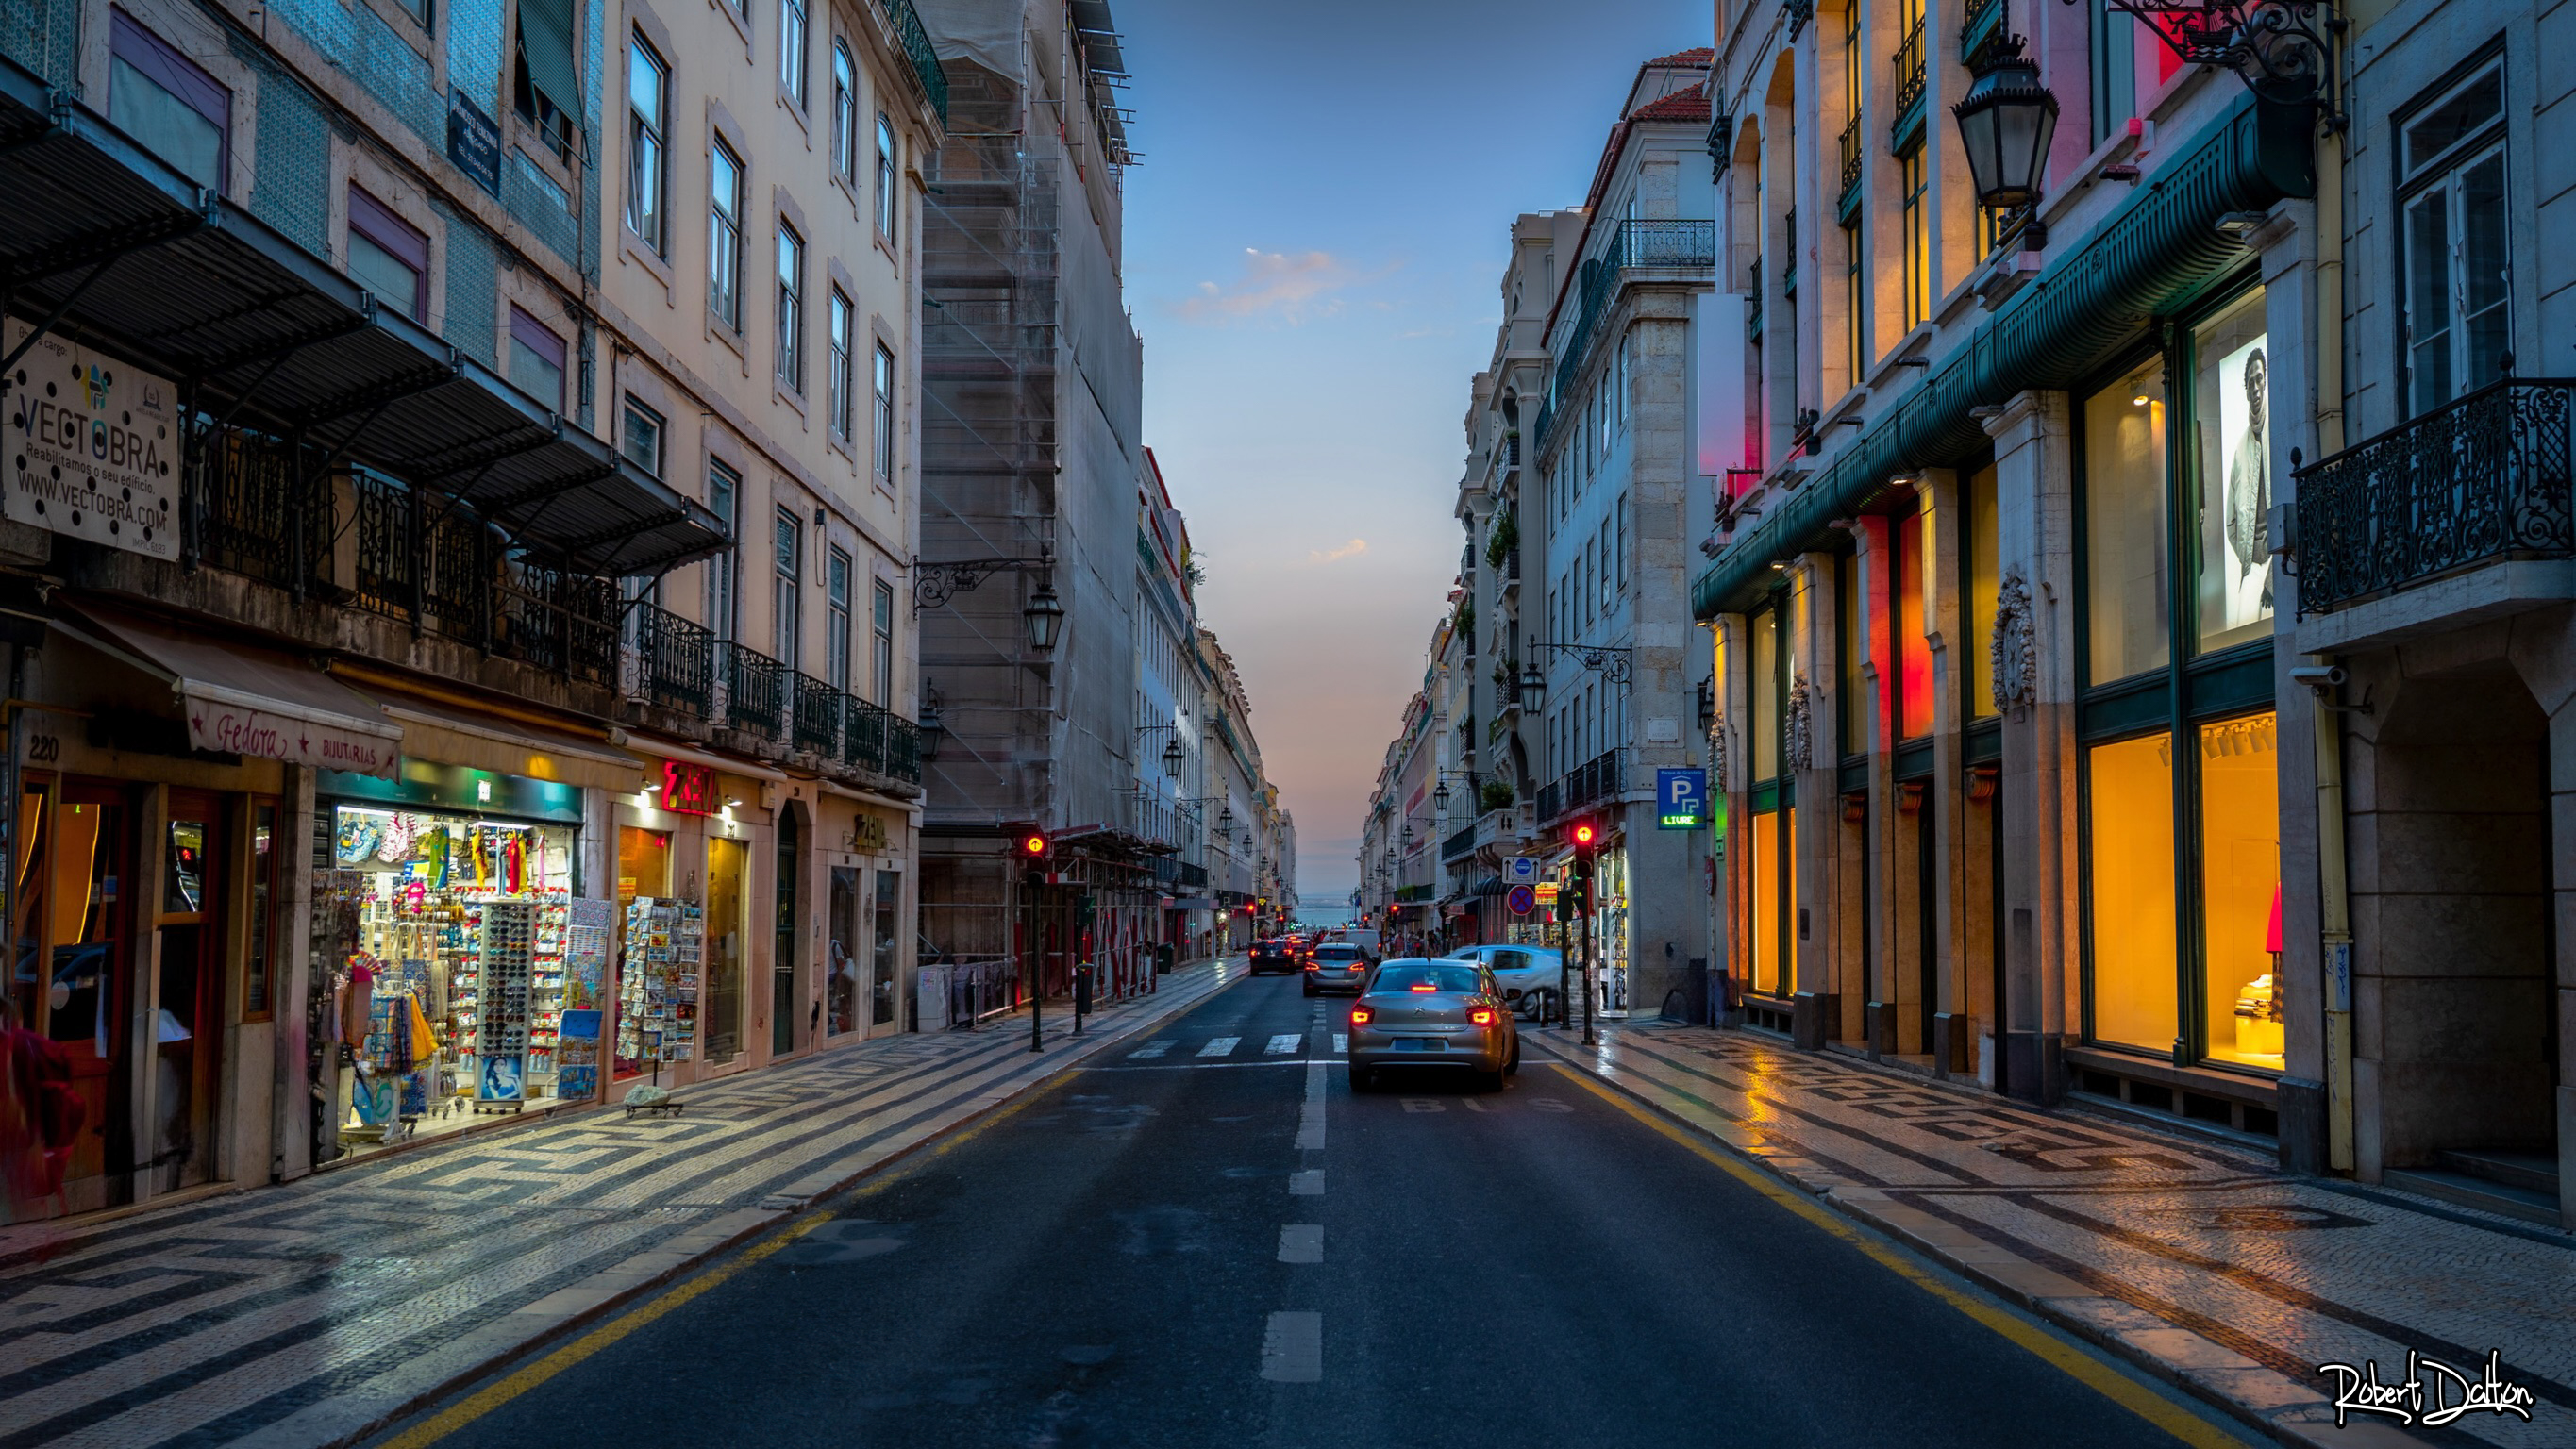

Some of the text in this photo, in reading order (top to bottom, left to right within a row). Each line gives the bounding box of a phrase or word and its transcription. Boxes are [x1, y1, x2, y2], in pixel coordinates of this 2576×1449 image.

[44, 340, 68, 357] cargo:
[20, 393, 159, 478] VECTOBRA
[26, 442, 92, 475] Reabilitamos
[94, 467, 99, 477] o
[102, 470, 118, 483] seu
[17, 470, 167, 531] WWW.VECTOBRA.COM
[151, 541, 166, 555] 6183
[29, 735, 59, 762] 220
[217, 709, 287, 758] Fedora
[323, 739, 376, 765] BIJUTARIAS
[663, 760, 723, 814] ZEVA
[1671, 780, 1692, 804] P
[854, 814, 887, 849] ZEVA
[1664, 815, 1695, 825] LIVRE
